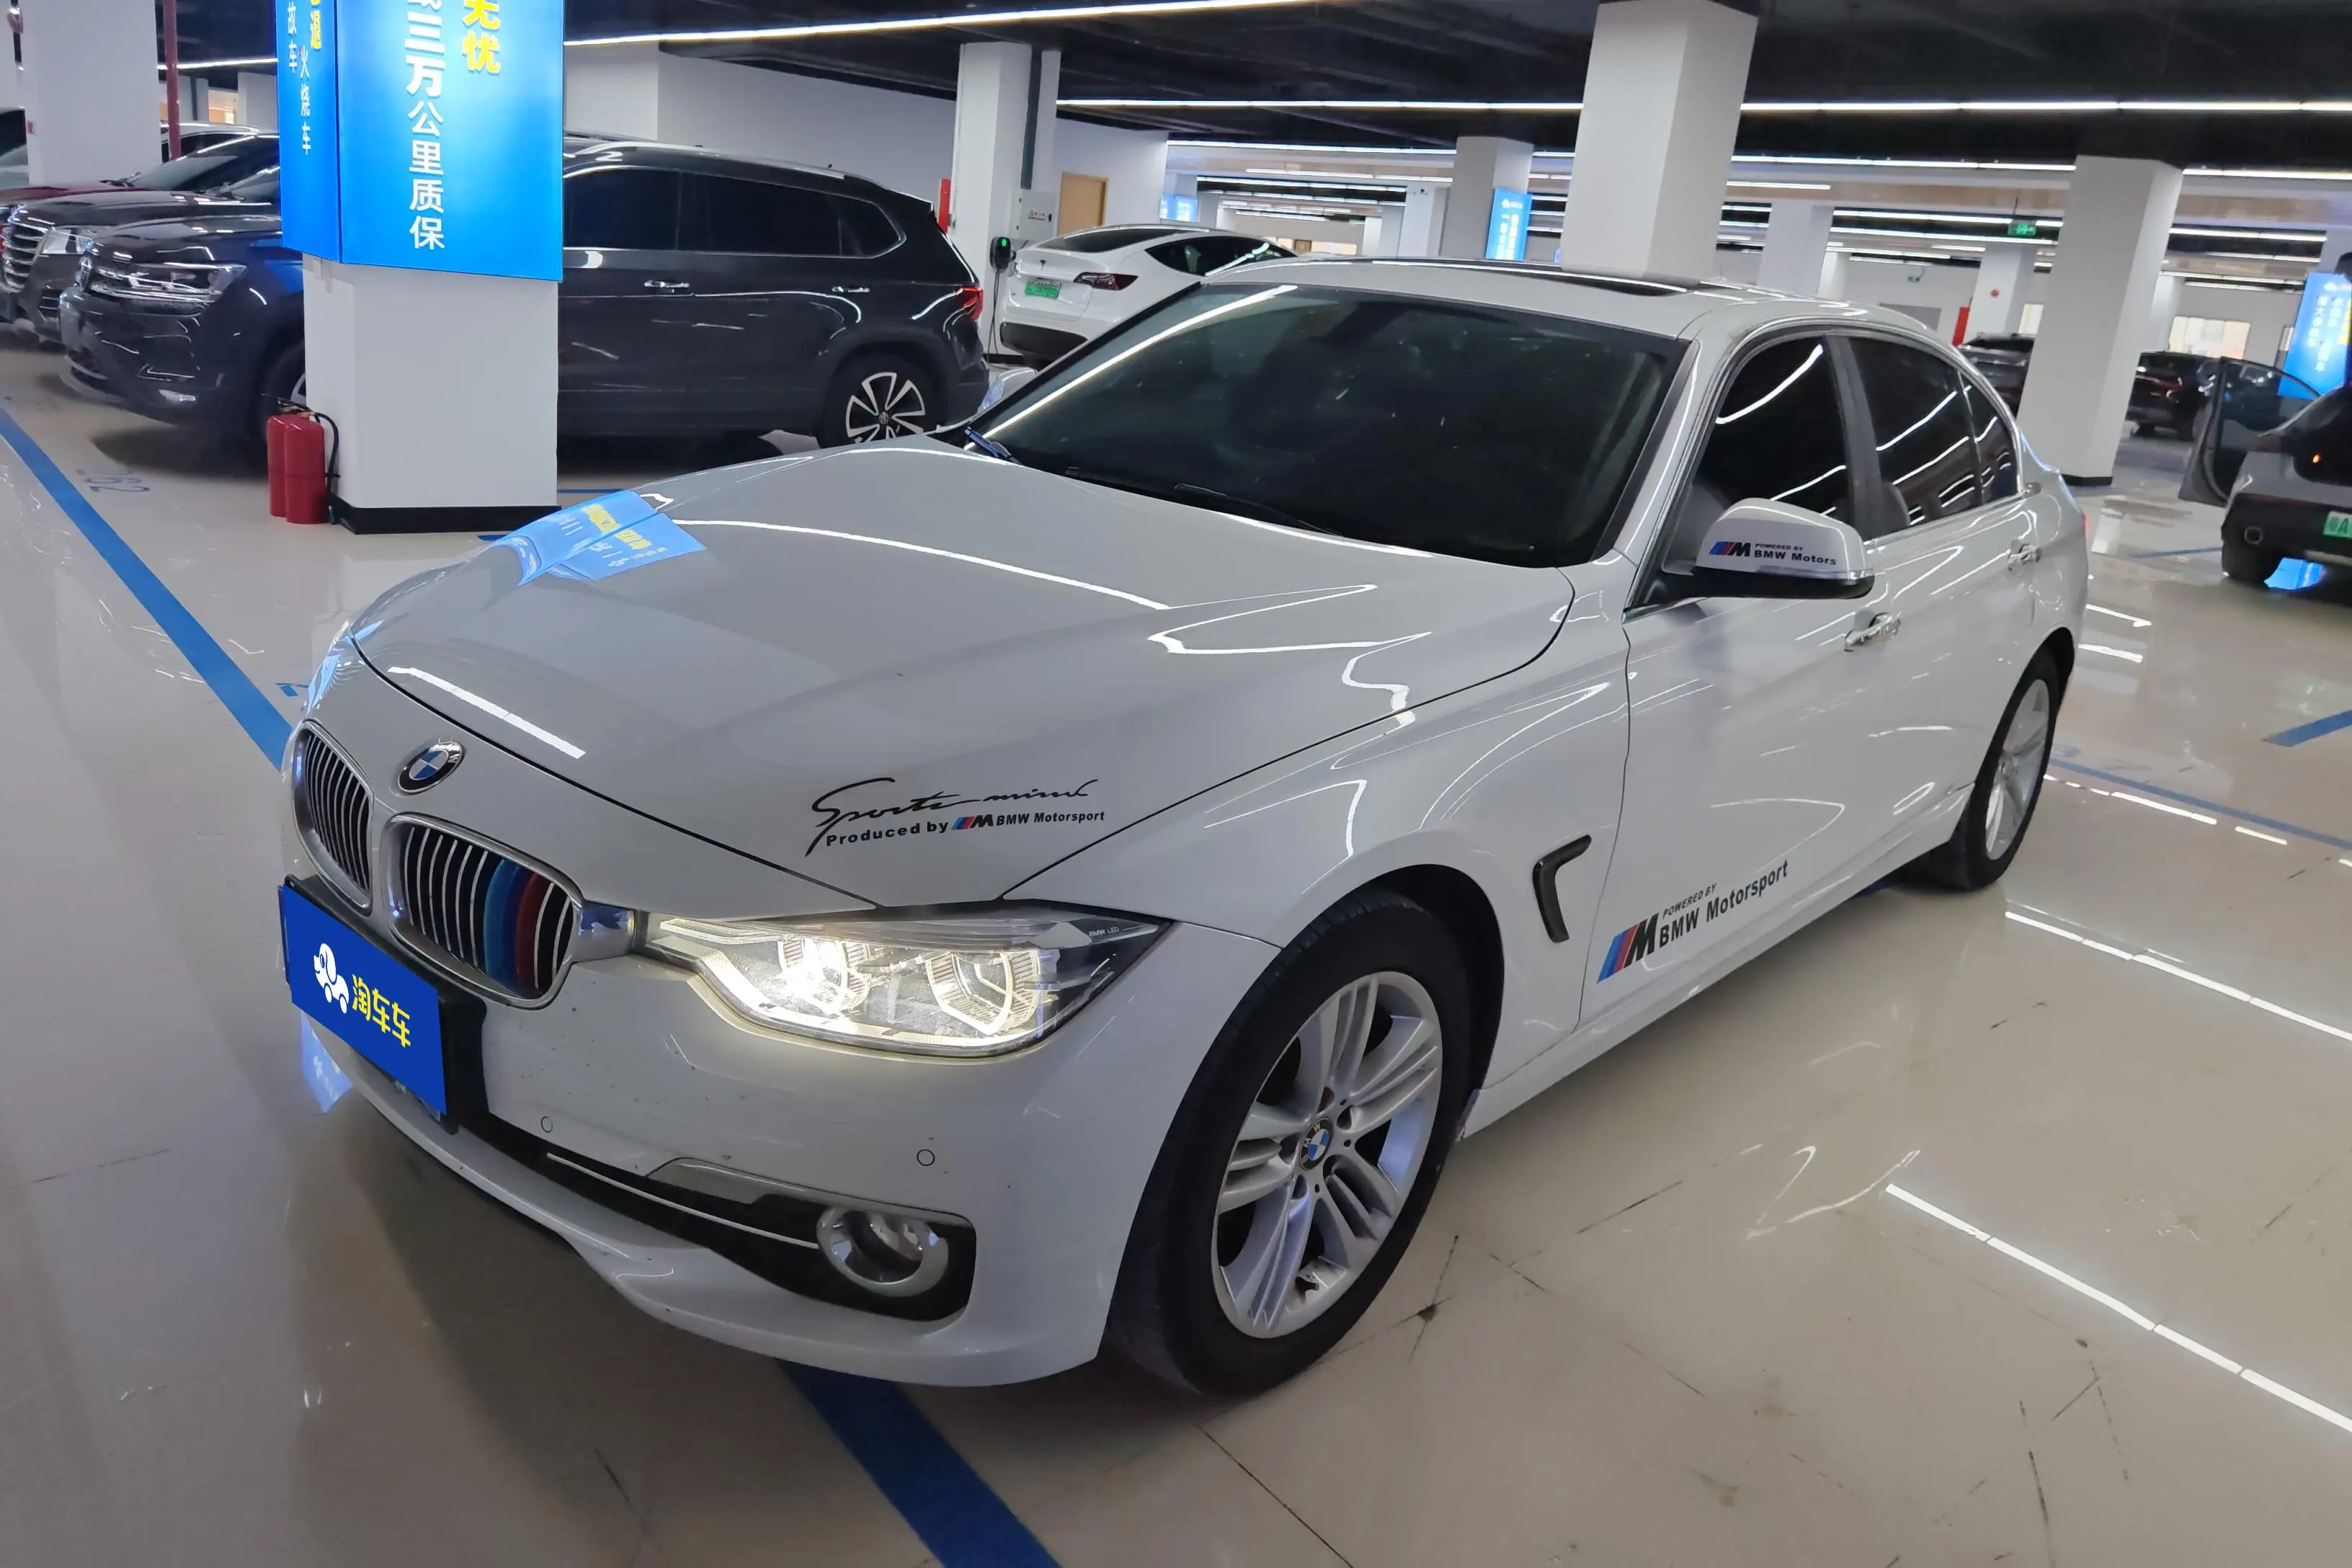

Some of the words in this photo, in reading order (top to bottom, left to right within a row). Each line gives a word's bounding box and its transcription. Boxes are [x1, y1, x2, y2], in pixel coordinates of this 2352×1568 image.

[300, 45, 311, 155] 火烧车
[405, 0, 445, 250] 三万公里质保
[1754, 550, 1786, 560] BMW
[826, 823, 920, 847] Produced
[927, 821, 949, 834] by
[996, 813, 1030, 827] BMW
[1034, 811, 1105, 824] Motorsport
[1659, 907, 1700, 948] BMW
[1706, 859, 1788, 923] Motorsport
